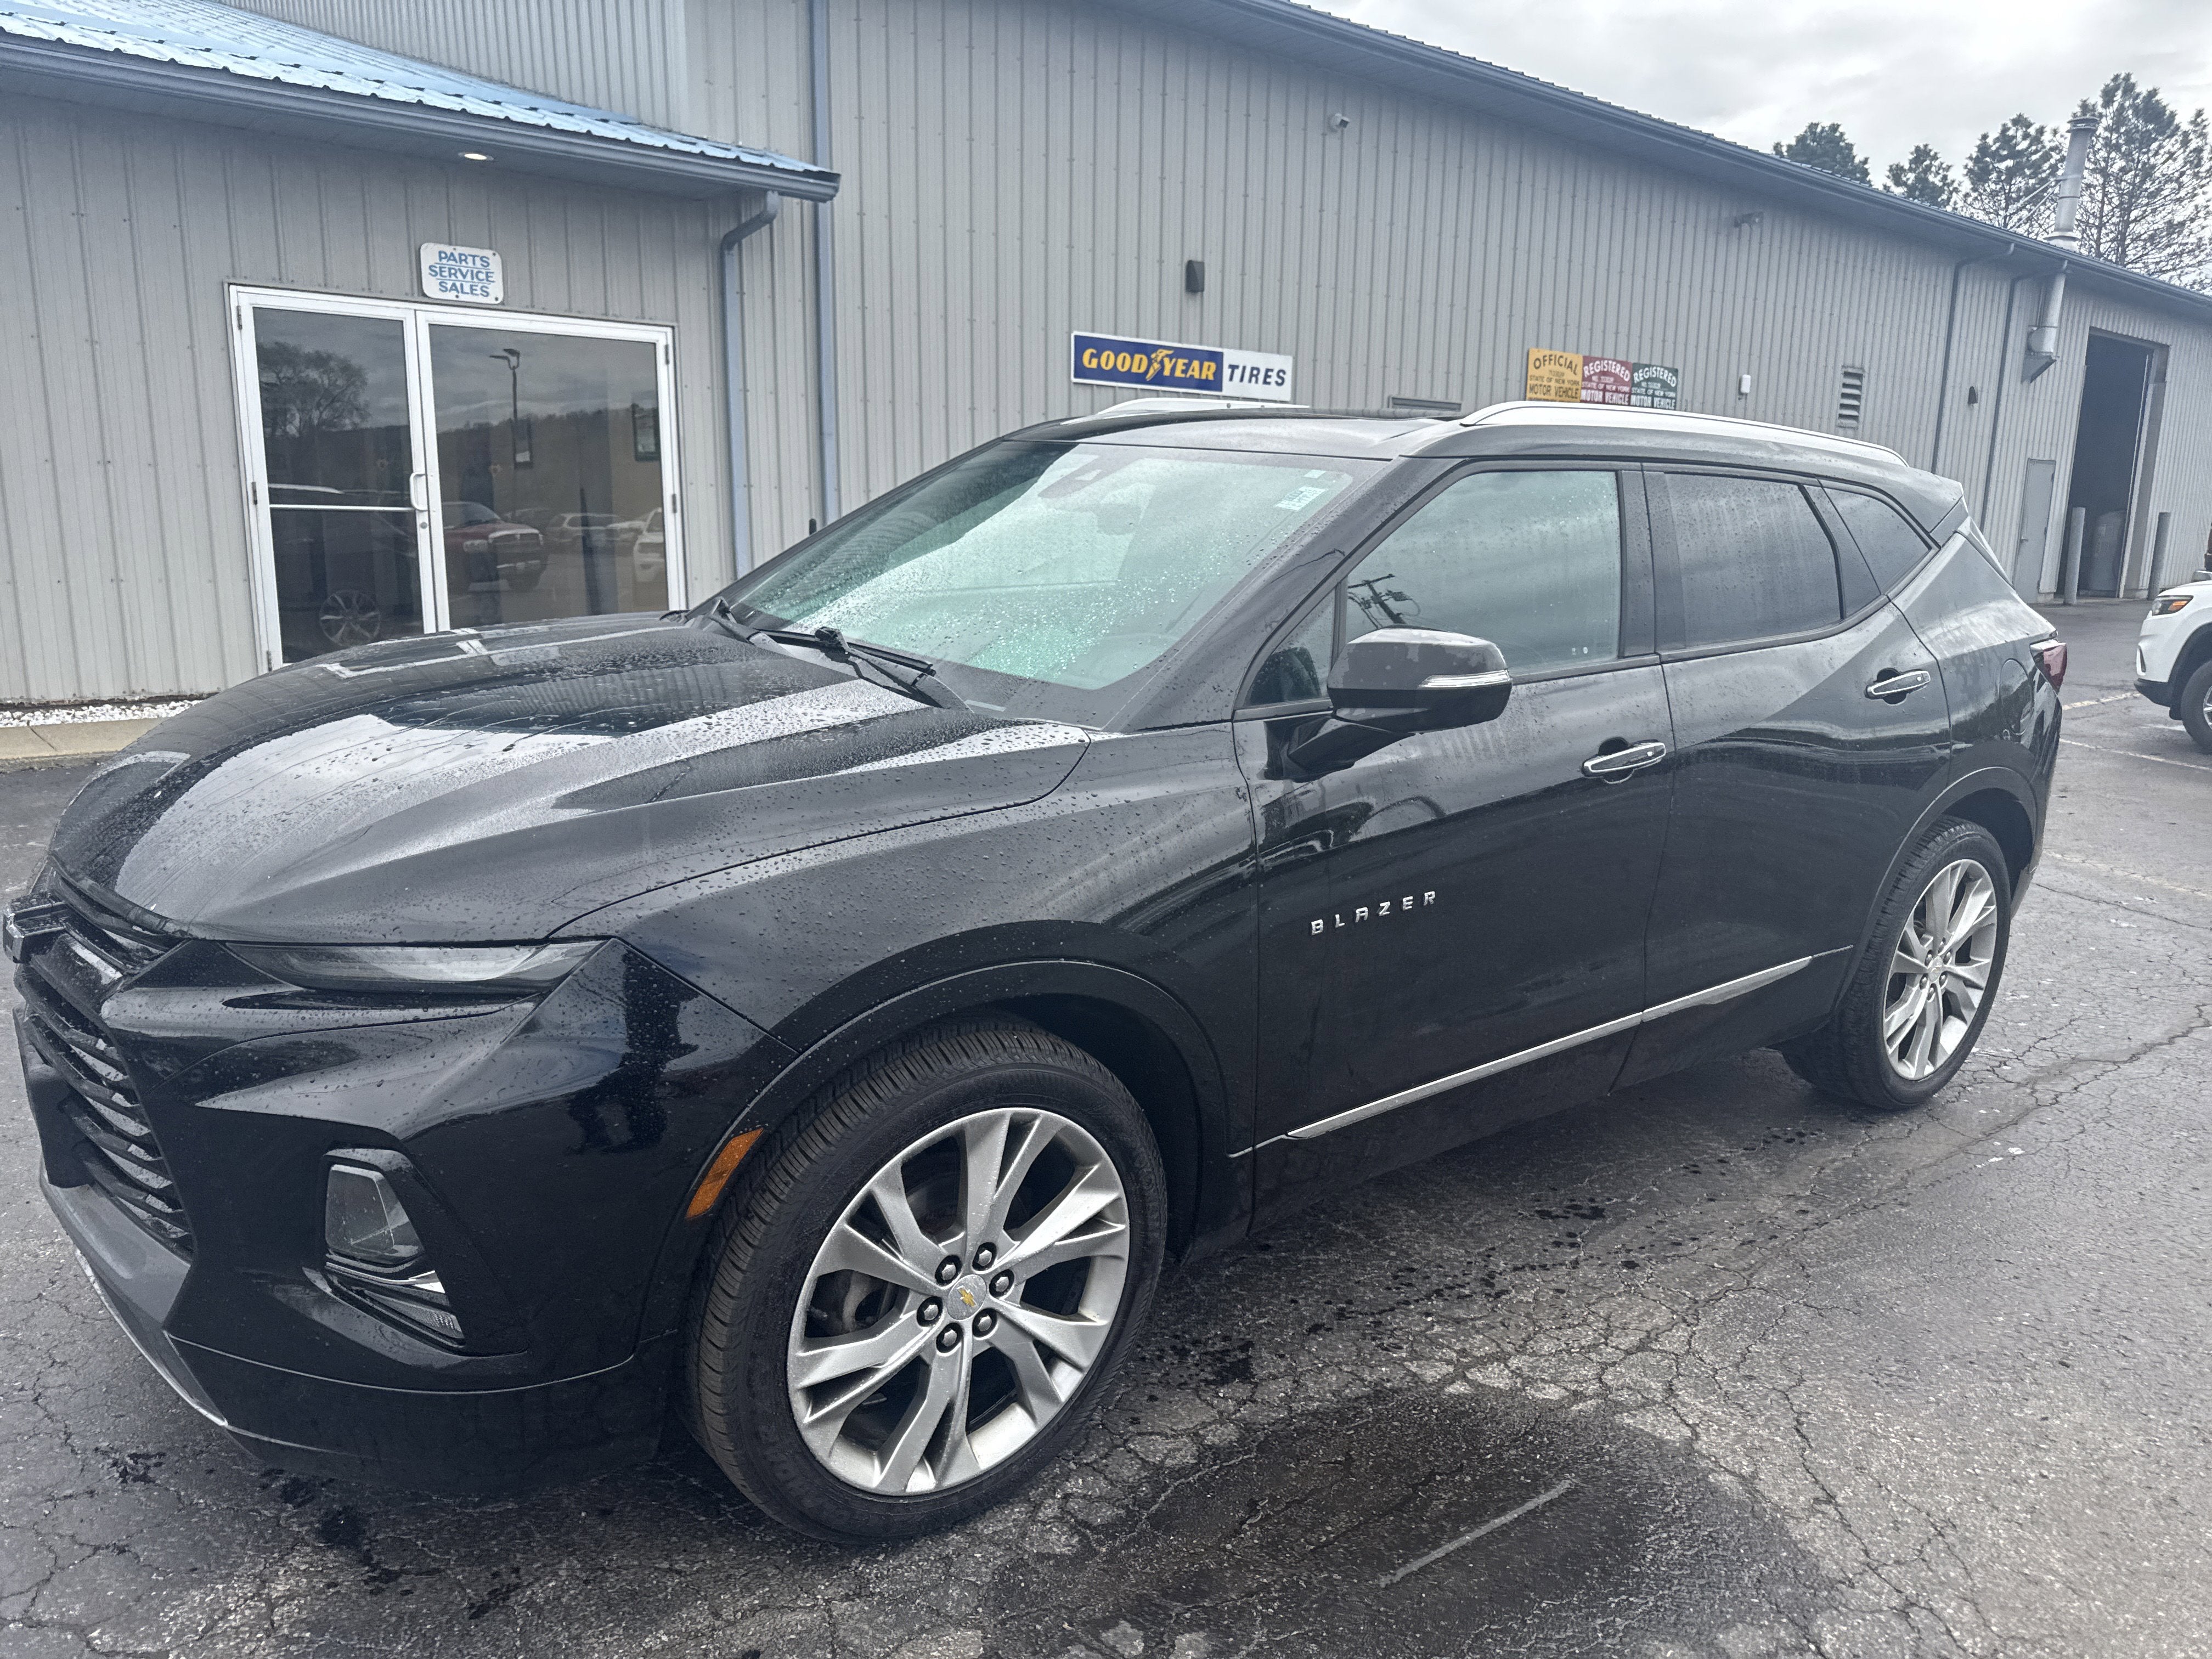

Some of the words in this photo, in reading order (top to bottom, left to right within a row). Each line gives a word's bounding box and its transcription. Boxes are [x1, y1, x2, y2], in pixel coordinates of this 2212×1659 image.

[438, 250, 490, 268] PARTS
[428, 264, 495, 283] SERVICE
[438, 281, 489, 297] SALES
[1533, 354, 1577, 376] OFFICIAL
[1583, 360, 1630, 382] REGISTERED
[1228, 364, 1286, 386] TIRES
[1633, 366, 1677, 387] REGISTERED
[1528, 383, 1551, 396] MOTOR
[1555, 386, 1579, 399] VEHICLE
[1581, 389, 1603, 402] MOTOR
[1605, 392, 1629, 405] VEHICLE
[1630, 395, 1652, 408] MOTOR
[1654, 397, 1675, 410] VEHICLE
[1311, 890, 1436, 936] BLAZER
